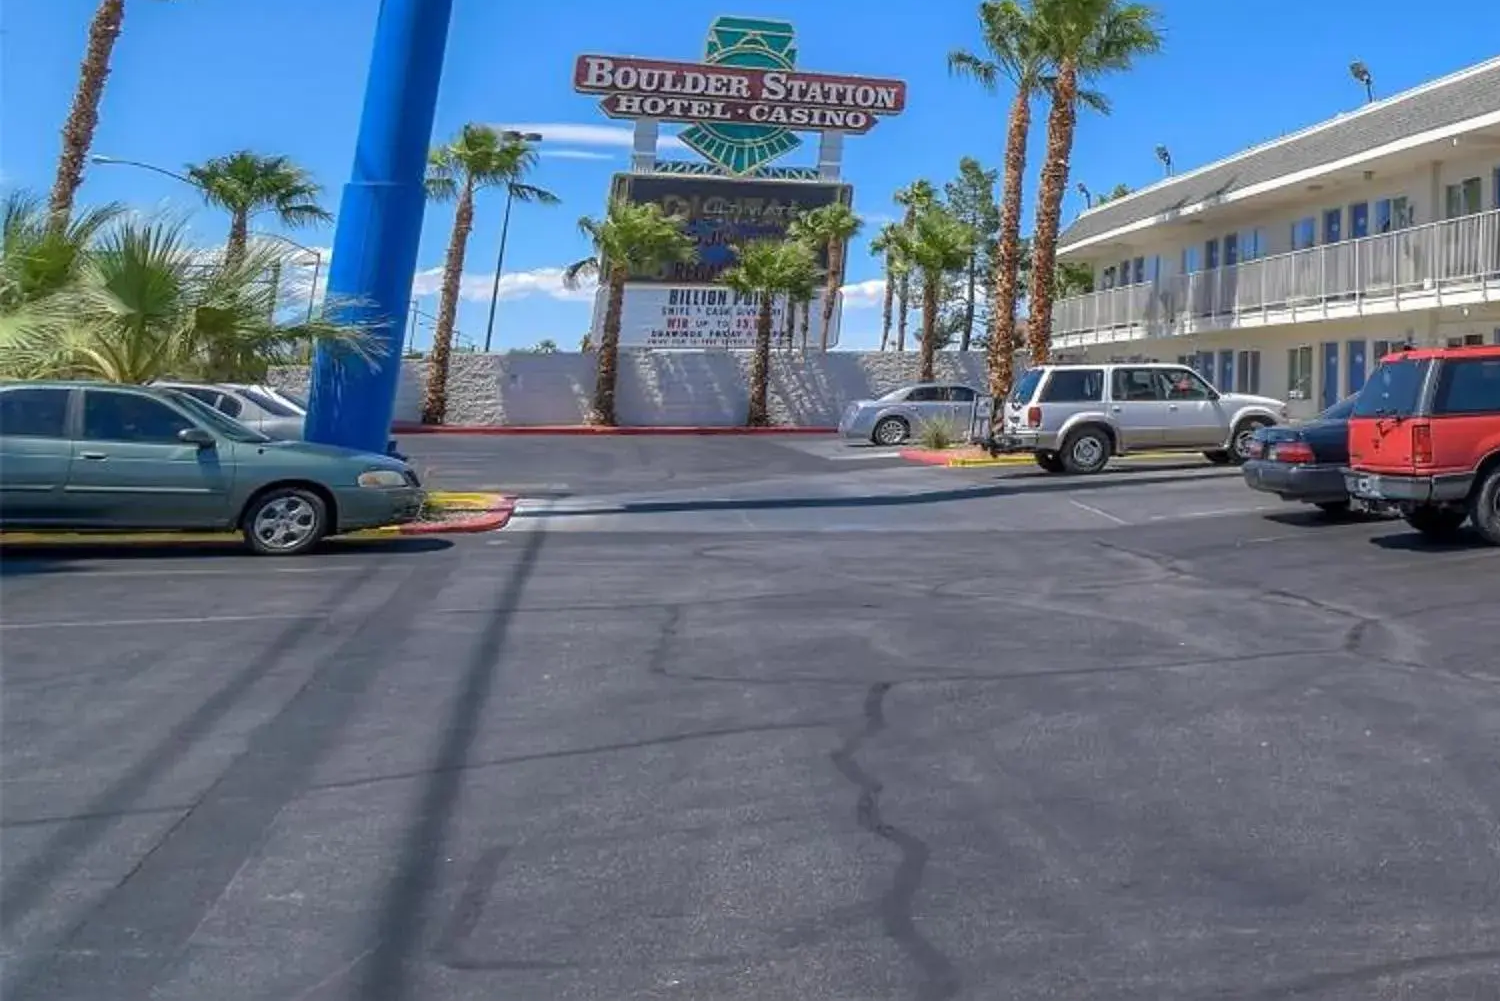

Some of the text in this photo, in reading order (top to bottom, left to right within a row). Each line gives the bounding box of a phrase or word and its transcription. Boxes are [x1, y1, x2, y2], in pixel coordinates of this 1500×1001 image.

[583, 57, 897, 109] BOULDER STATION
[615, 94, 867, 128] HOTEL CASINO
[669, 289, 727, 306] BILLION
